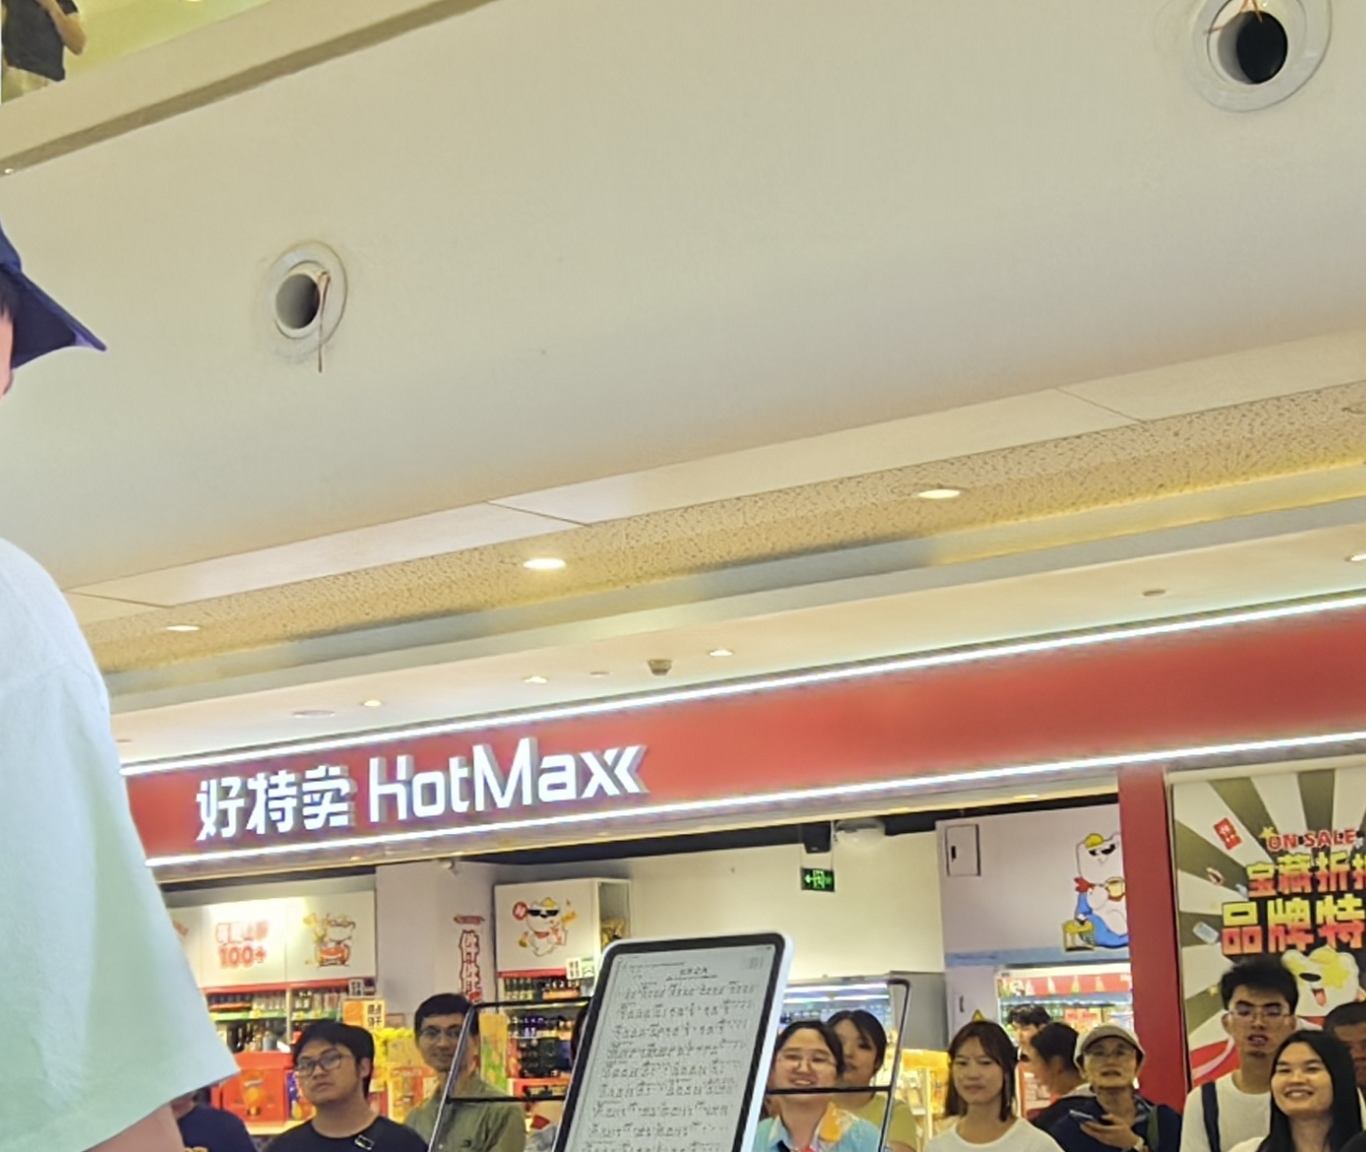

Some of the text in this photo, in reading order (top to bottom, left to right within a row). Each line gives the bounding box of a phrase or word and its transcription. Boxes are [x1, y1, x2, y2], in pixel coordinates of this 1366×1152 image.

[195, 764, 355, 842] 好特卖
[1266, 828, 1356, 851] ON SALE
